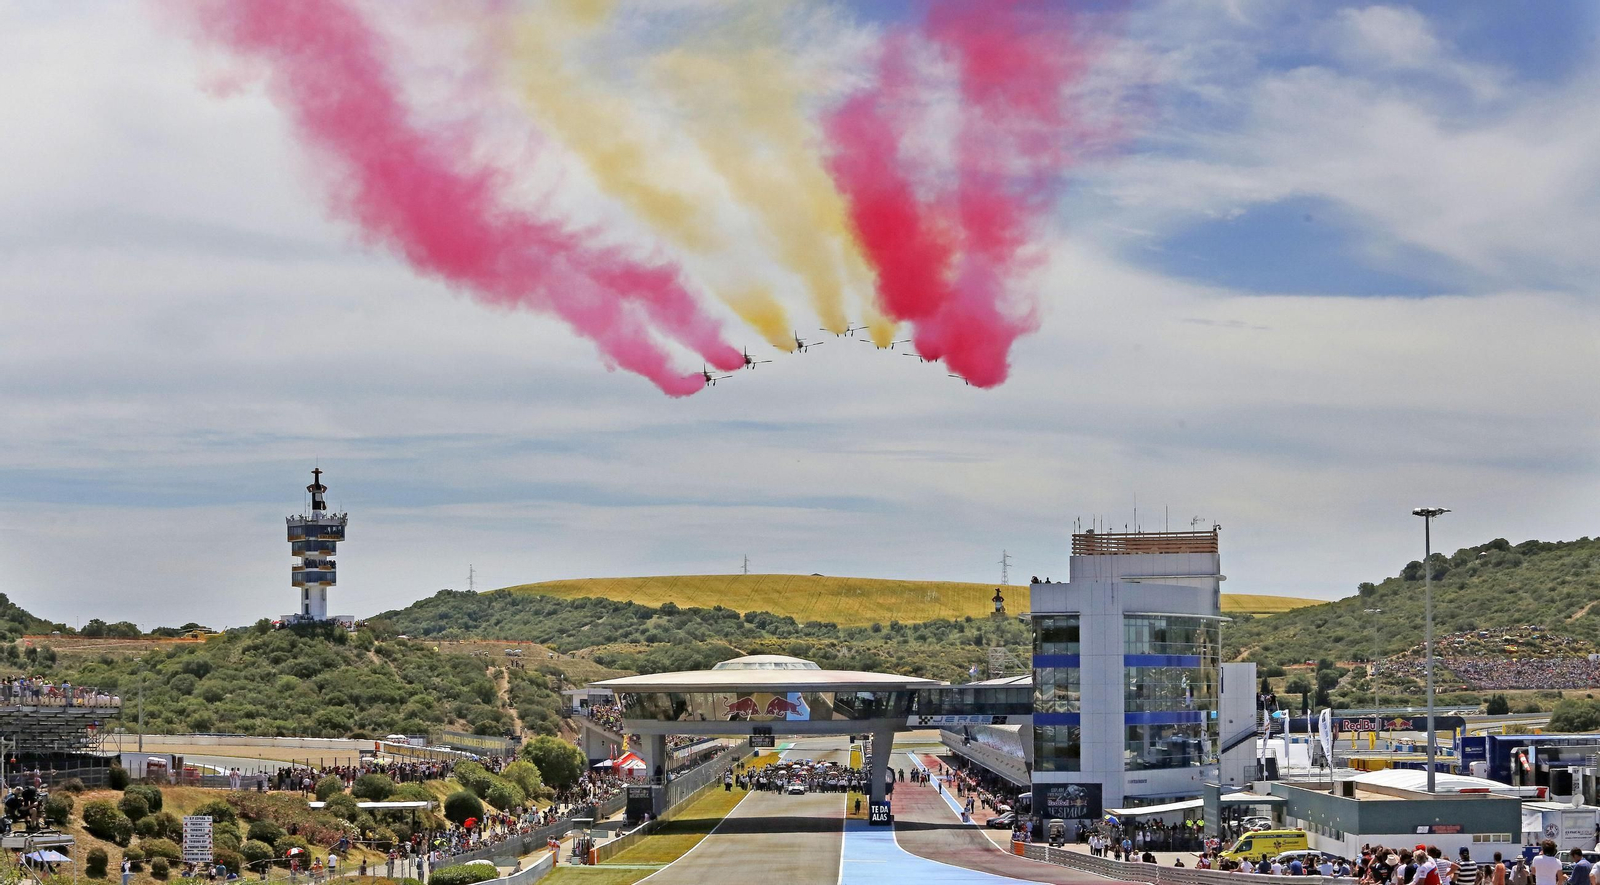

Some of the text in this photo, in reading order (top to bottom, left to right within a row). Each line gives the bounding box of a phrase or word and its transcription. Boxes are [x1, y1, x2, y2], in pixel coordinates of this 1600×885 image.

[1343, 719, 1382, 731] Red Bul
[871, 805, 889, 813] TE DA
[872, 813, 888, 821] ALAS
